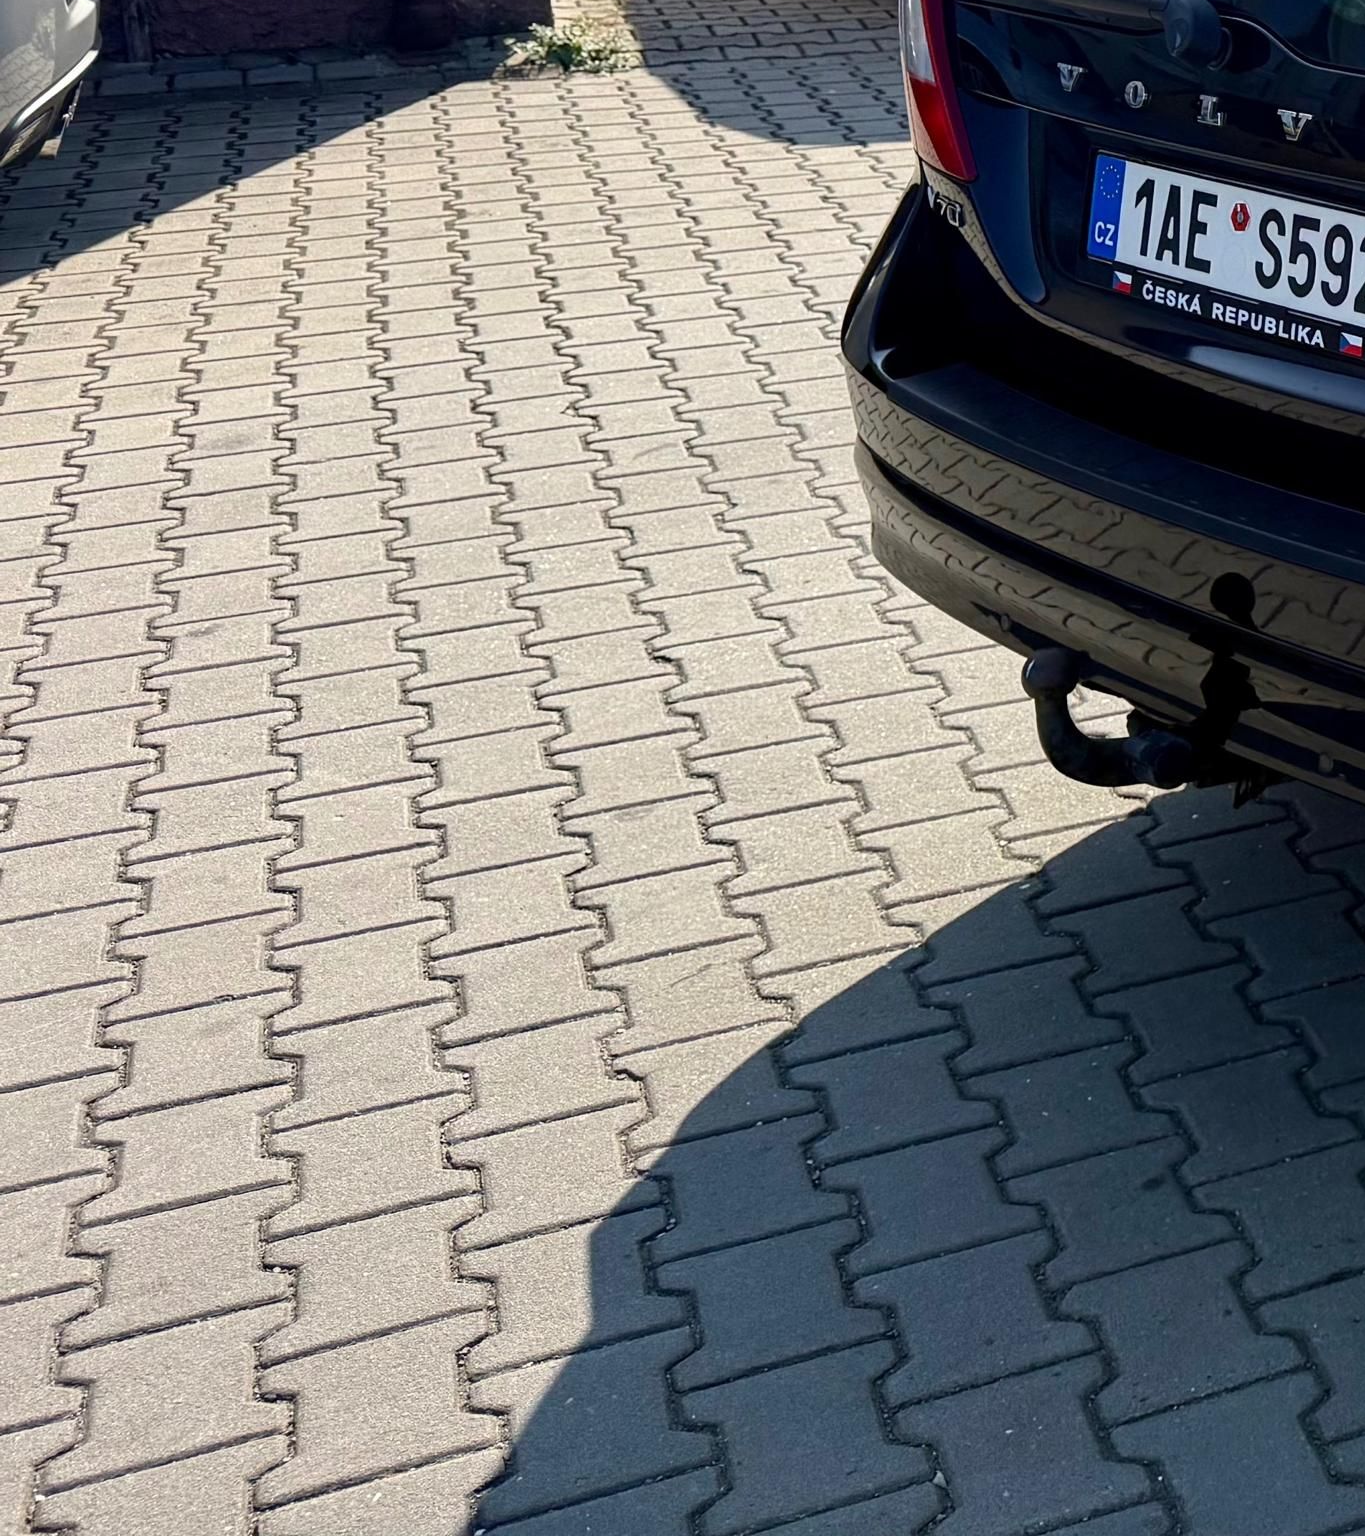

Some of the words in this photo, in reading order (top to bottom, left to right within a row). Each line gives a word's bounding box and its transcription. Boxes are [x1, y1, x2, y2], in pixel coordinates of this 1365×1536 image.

[927, 186, 961, 227] V70
[1094, 221, 1115, 247] CZ
[1134, 177, 1218, 274] 1AE
[1141, 279, 1202, 317] ČESKÁ
[1212, 303, 1325, 349] REPUBLIKA
